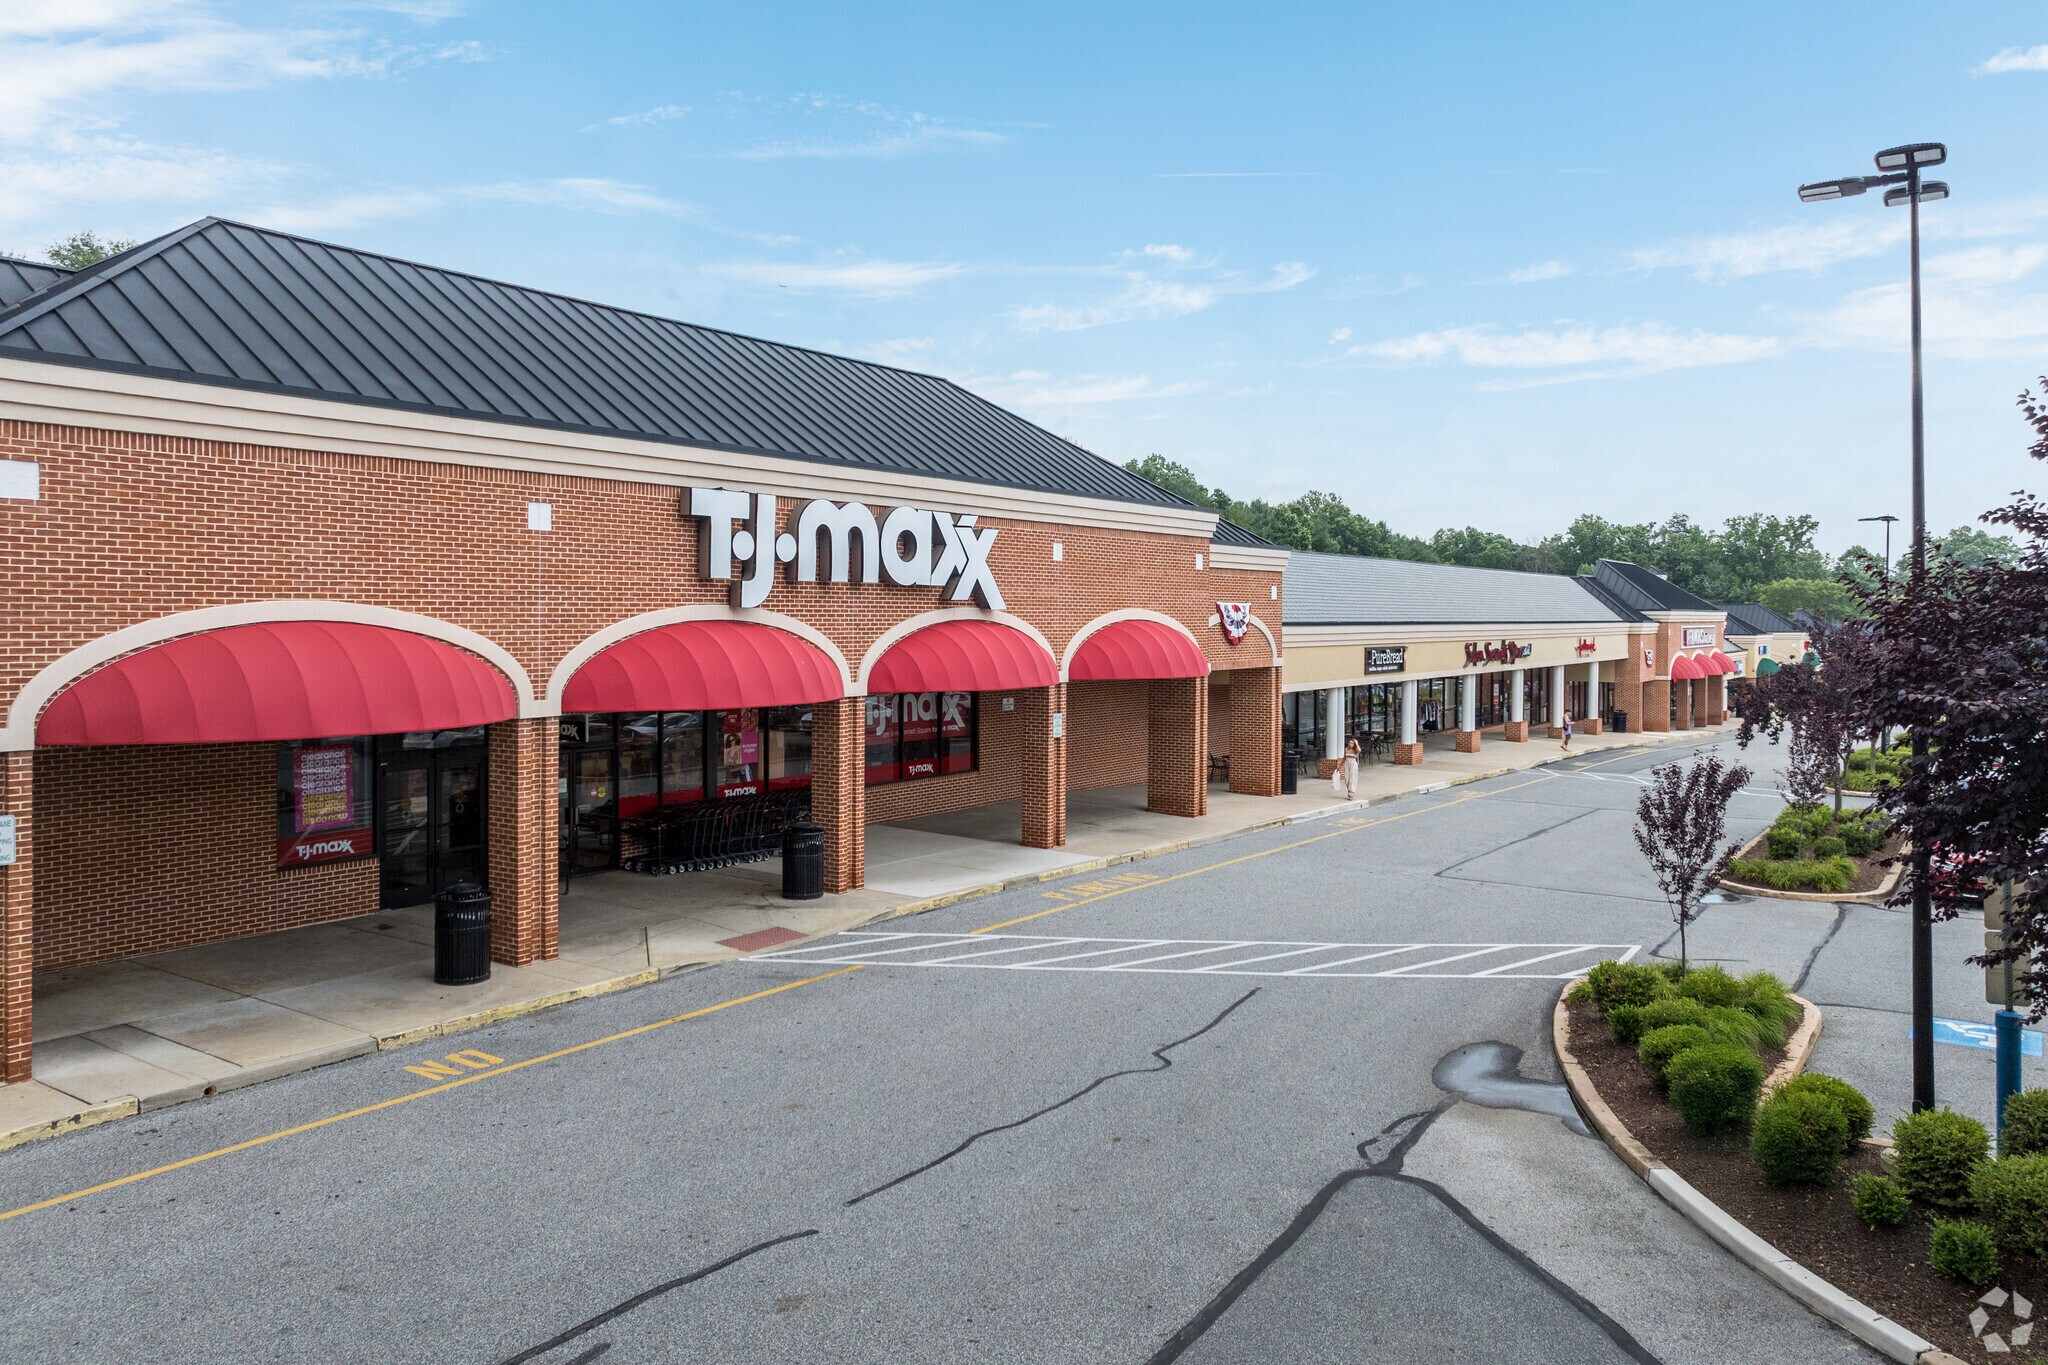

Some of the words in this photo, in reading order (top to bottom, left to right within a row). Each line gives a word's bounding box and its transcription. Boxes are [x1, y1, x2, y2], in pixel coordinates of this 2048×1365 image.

[301, 750, 346, 760] clearance
[301, 758, 346, 768] clearance
[302, 764, 346, 775] clearance
[302, 771, 346, 782] clearance
[302, 778, 346, 789] clearance
[302, 784, 346, 796] clearance
[303, 792, 347, 803] clearance
[303, 798, 347, 810] clearance
[303, 805, 347, 816] clearance
[328, 812, 348, 821] now
[402, 1049, 505, 1081] NO
